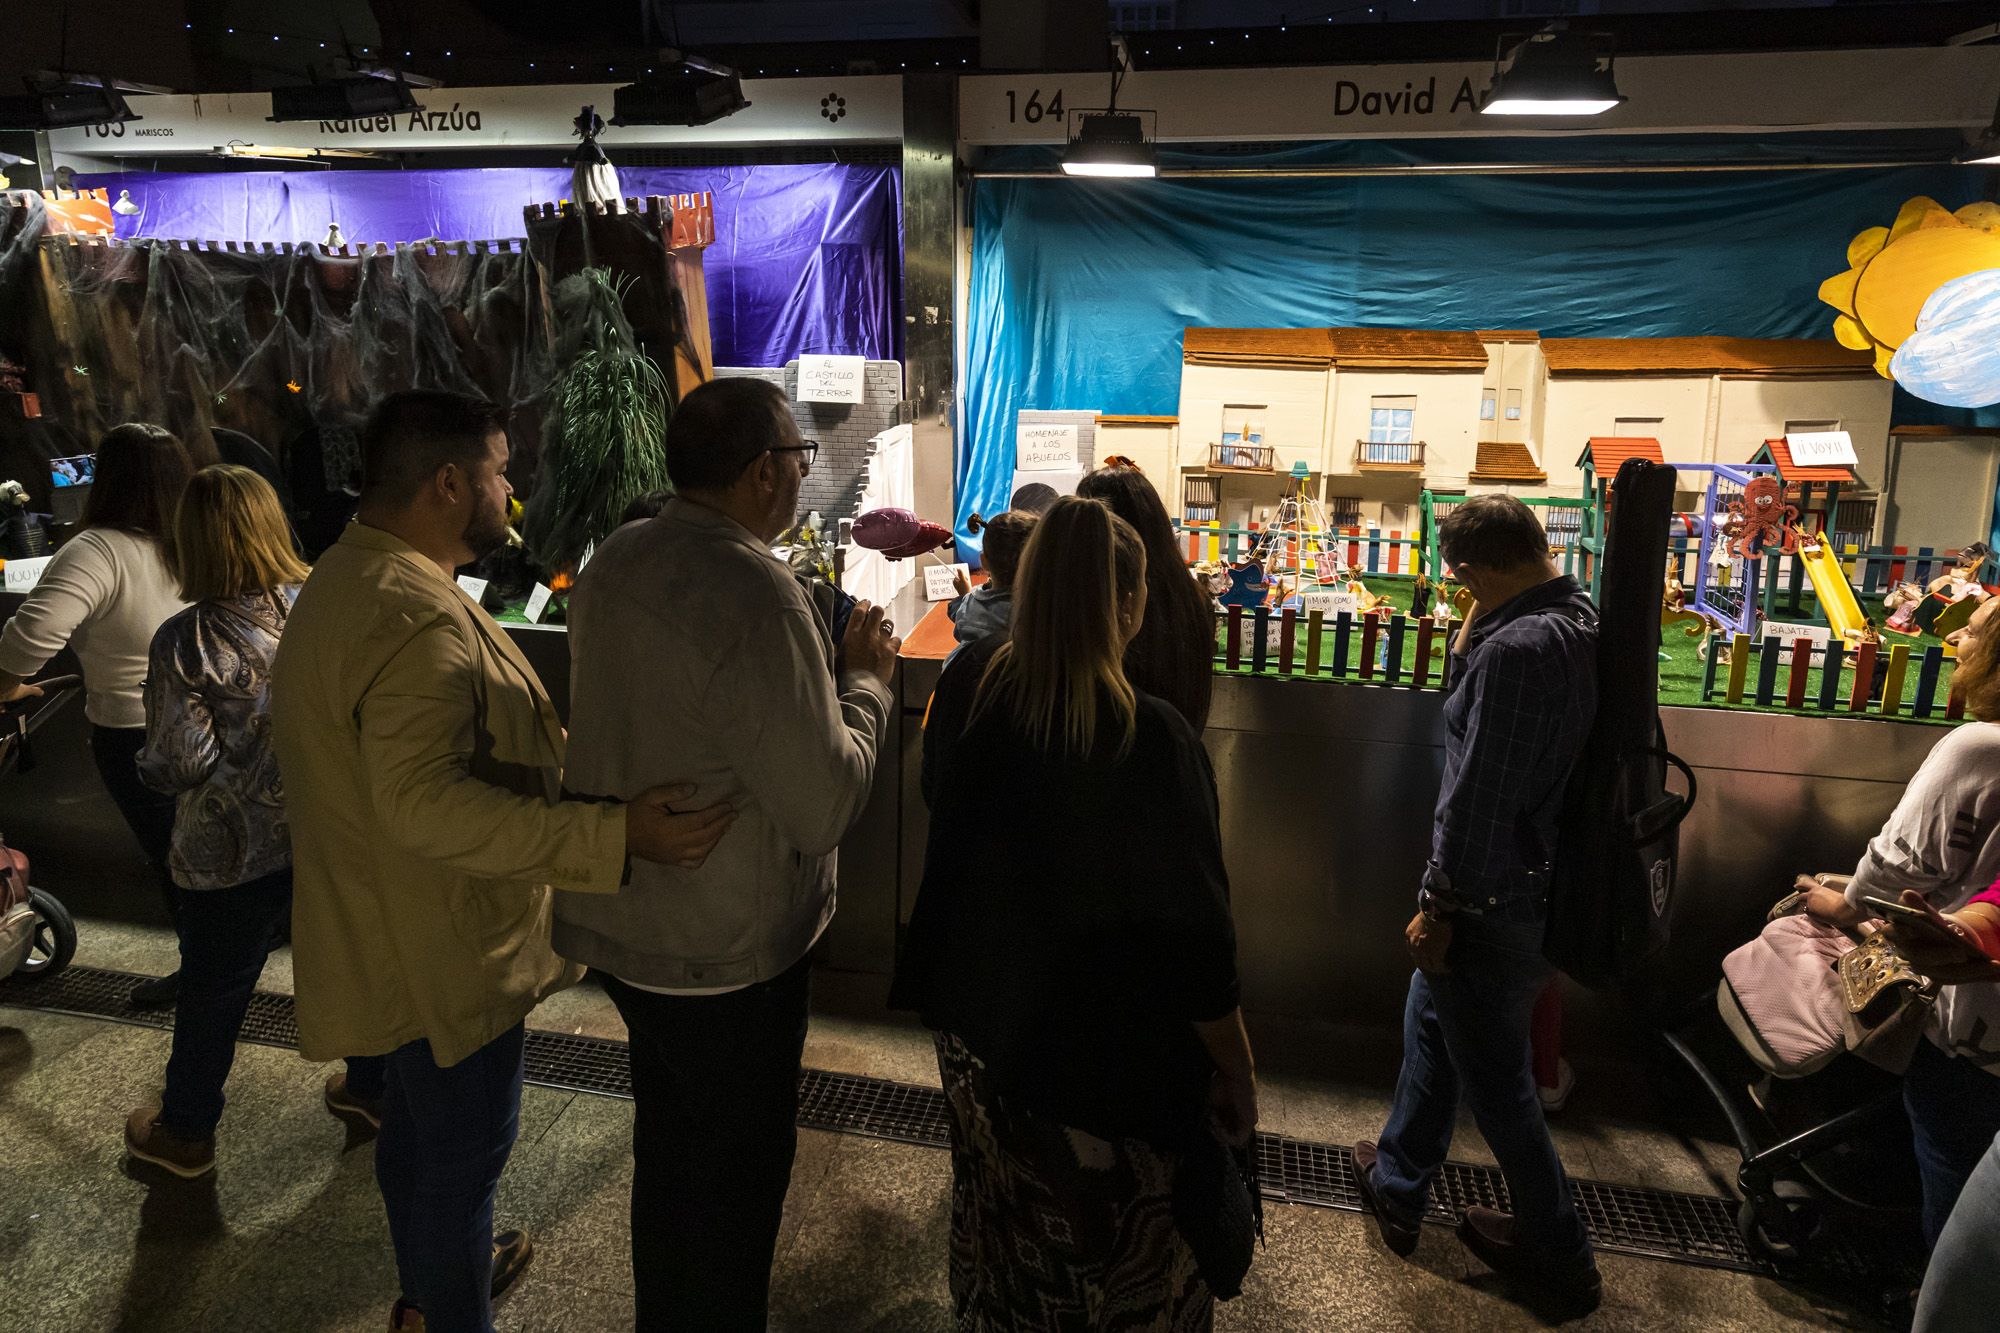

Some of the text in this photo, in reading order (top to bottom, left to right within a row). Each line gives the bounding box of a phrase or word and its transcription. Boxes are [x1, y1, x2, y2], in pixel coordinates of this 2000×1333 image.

[1334, 76, 1436, 116] David
[1006, 88, 1064, 123] 164
[408, 102, 481, 132] Arzúa
[135, 128, 174, 137] MARISCOS
[823, 359, 833, 368] EL
[806, 370, 854, 379] CASTILLO
[820, 379, 835, 387] DEL
[807, 388, 853, 397] TERROR
[1025, 430, 1069, 438] HOMENAJE
[1043, 440, 1060, 448] LOS
[1026, 452, 1072, 463] ABUELOS
[1769, 625, 1813, 635] BAJATE
